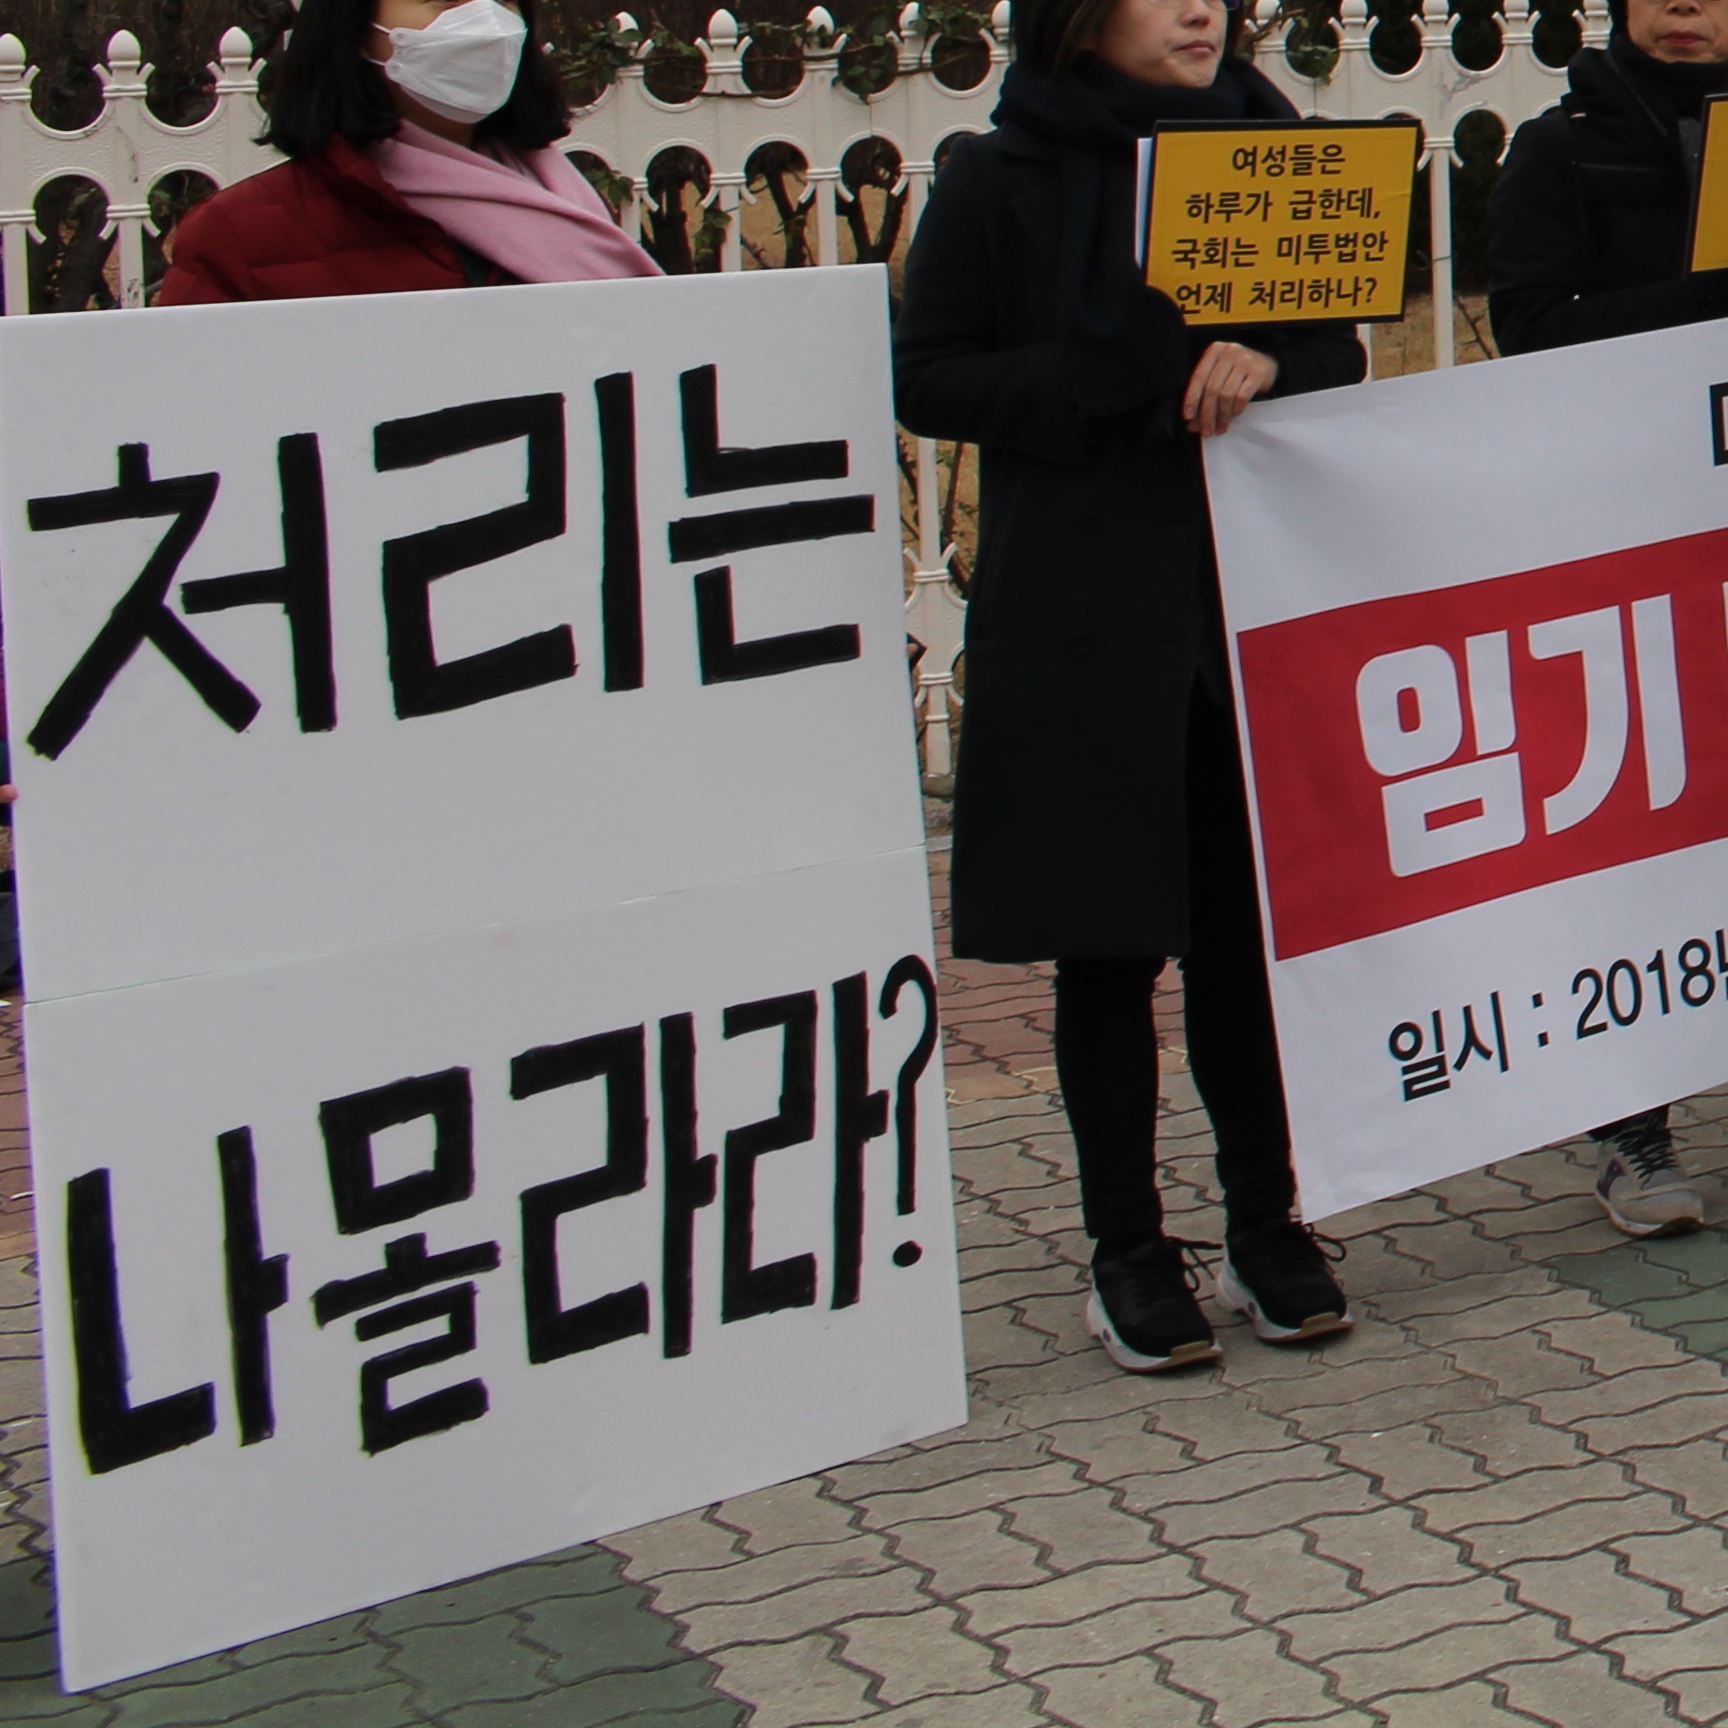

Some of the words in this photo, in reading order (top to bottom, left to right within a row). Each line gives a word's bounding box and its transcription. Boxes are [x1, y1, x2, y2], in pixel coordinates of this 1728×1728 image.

[1232, 144, 1346, 177] 여성들은
[1186, 191, 1272, 224] 하루가
[1289, 187, 1381, 220] 급한데,
[1172, 237, 1259, 270] 국회는
[1277, 231, 1388, 265] 미투법안
[1176, 282, 1232, 315] 언제
[1248, 276, 1378, 310] 처리하나?
[27, 363, 875, 761] 처리는
[1355, 592, 1688, 878] 임기
[1388, 990, 1511, 1102] 일시
